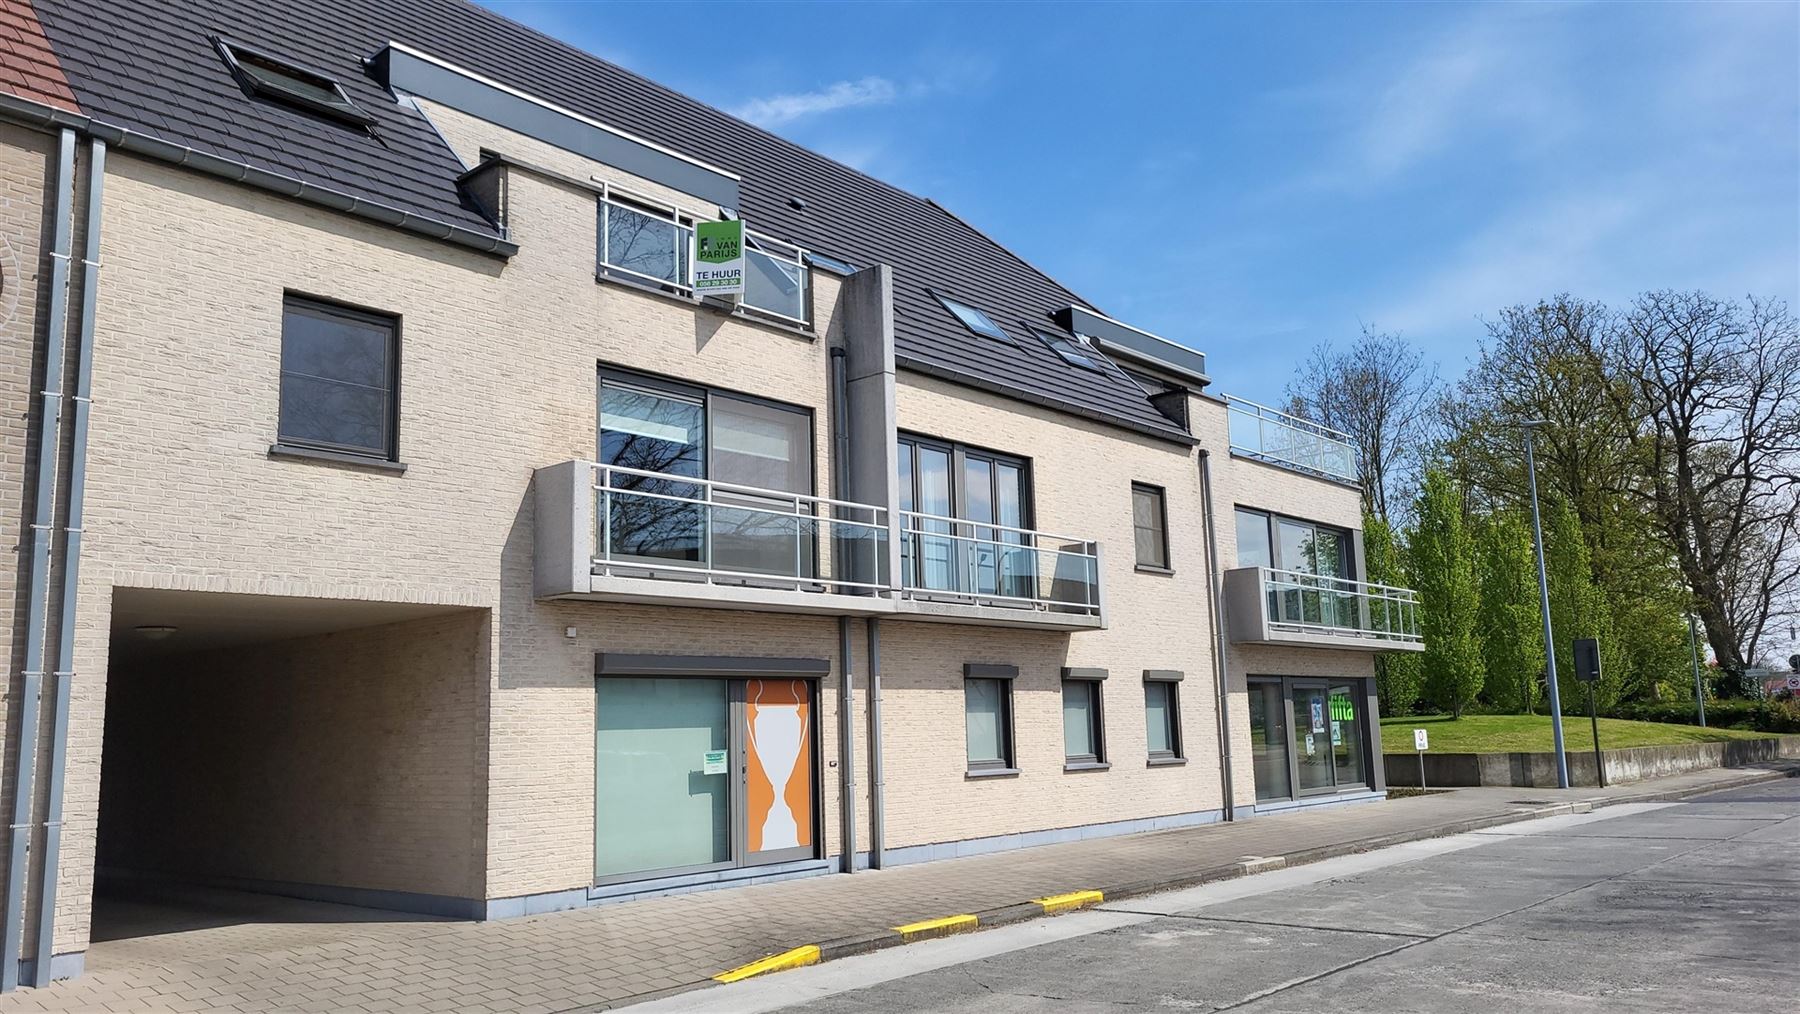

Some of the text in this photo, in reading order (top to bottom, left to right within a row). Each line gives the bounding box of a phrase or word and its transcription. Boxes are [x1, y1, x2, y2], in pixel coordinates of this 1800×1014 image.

[717, 241, 737, 249] VAN
[701, 249, 737, 259] PARIJS
[696, 269, 741, 280] TE HUUR
